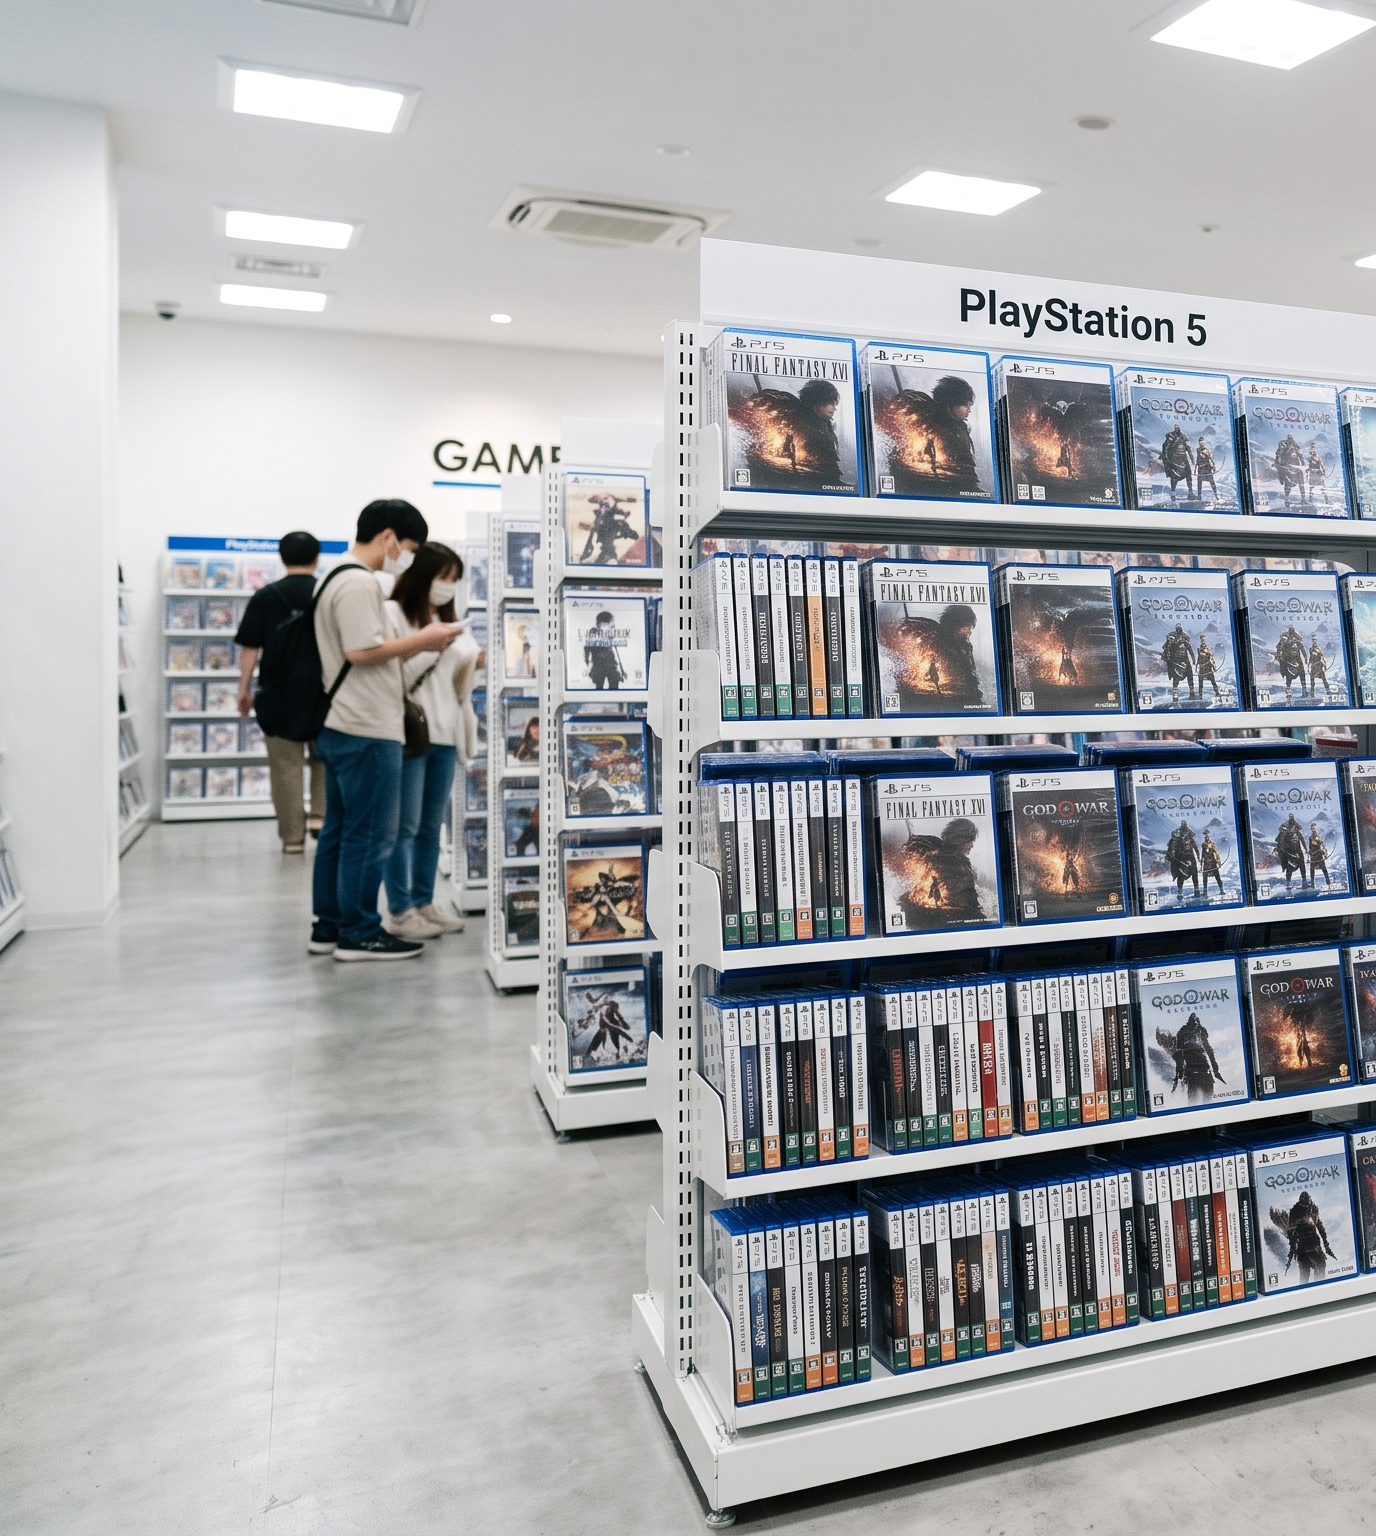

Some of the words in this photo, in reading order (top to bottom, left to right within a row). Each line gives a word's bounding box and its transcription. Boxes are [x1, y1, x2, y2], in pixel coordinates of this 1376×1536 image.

[960, 287, 1174, 344] PlayStation
[1186, 313, 1207, 346] 5
[750, 339, 786, 350] PS5
[892, 353, 924, 363] PS5
[731, 352, 768, 374] FINAL
[774, 356, 827, 379] FANTASY
[832, 362, 849, 381] XVI
[1024, 366, 1055, 375] PS5
[881, 583, 913, 601] FINAL
[901, 783, 932, 793] PS5
[1031, 777, 1061, 787] PS5
[886, 801, 918, 819] FINAL
[1022, 803, 1058, 816] GOD
[1074, 801, 1109, 814] WAR
[1260, 981, 1290, 999] GOD
[1304, 977, 1334, 990] WAR
[1151, 993, 1183, 1010] GOD
[1199, 988, 1230, 1003] WAR
